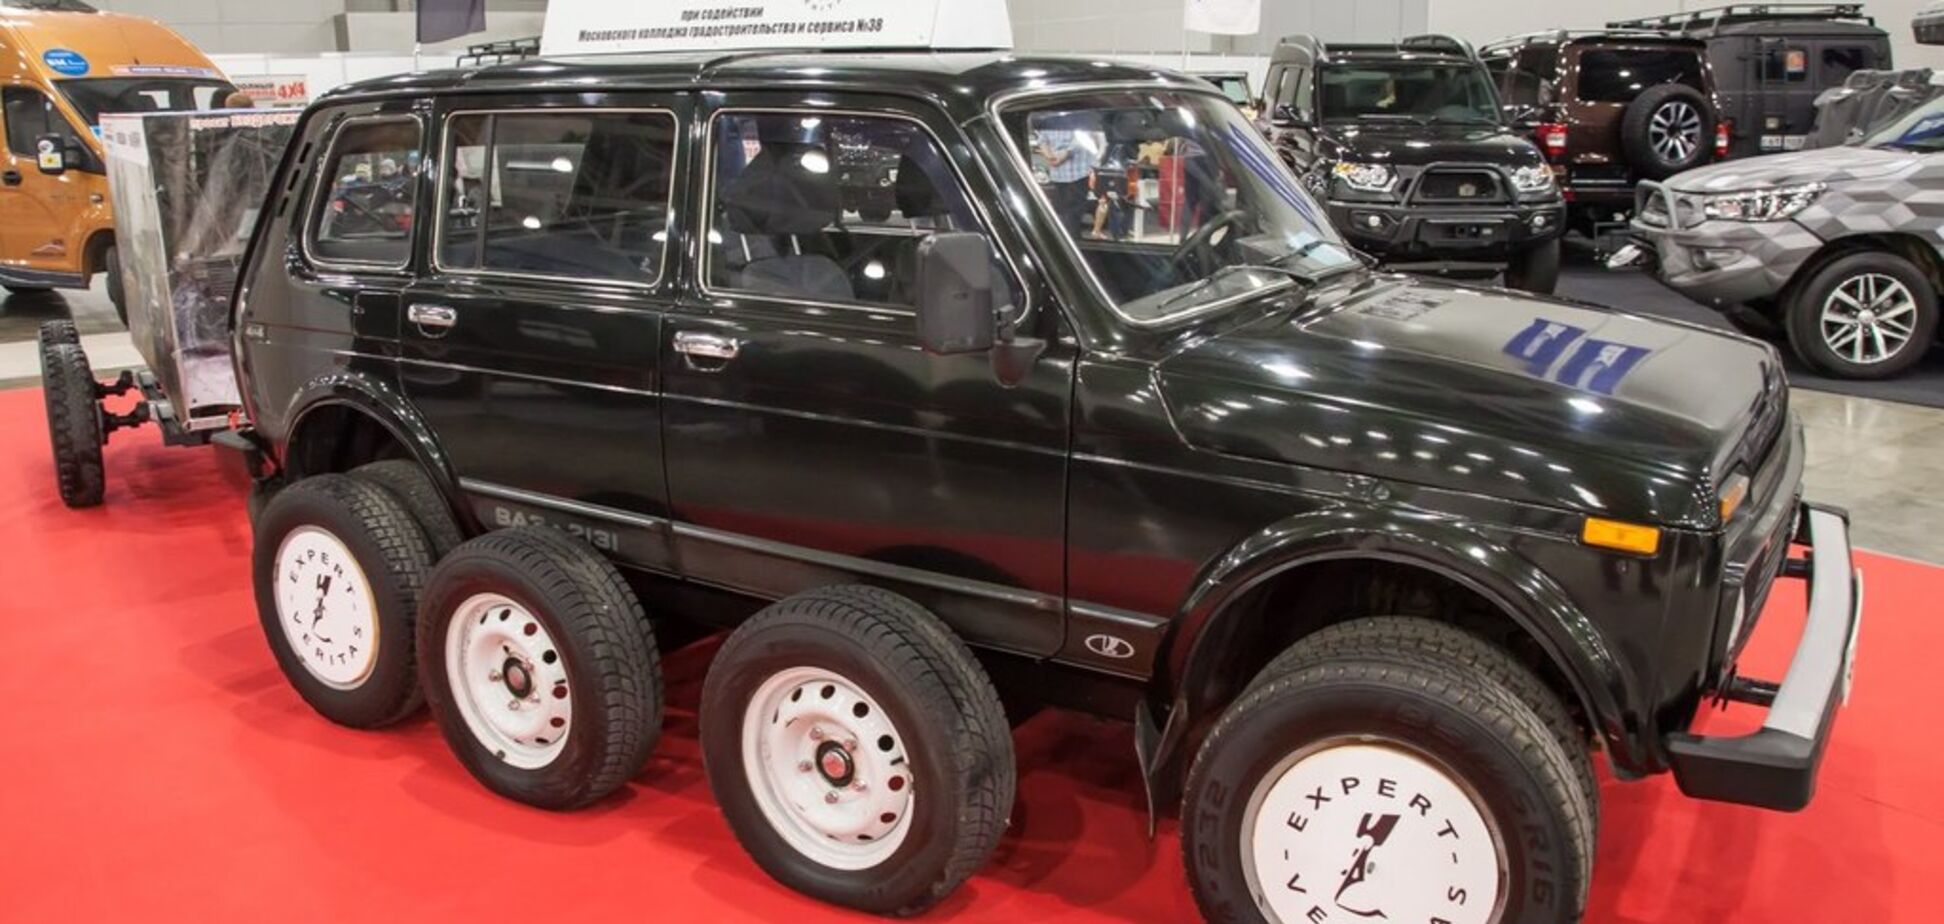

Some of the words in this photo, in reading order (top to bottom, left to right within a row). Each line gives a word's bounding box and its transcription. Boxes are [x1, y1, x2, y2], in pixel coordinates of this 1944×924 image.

[681, 10, 699, 22] при
[701, 6, 764, 21] содействии
[578, 29, 637, 42] Московского
[638, 26, 688, 39] колледжа
[689, 22, 796, 38] градостроительства
[797, 22, 806, 33] и
[807, 20, 854, 35] сервиса
[1287, 776, 1460, 843] EXPERT
